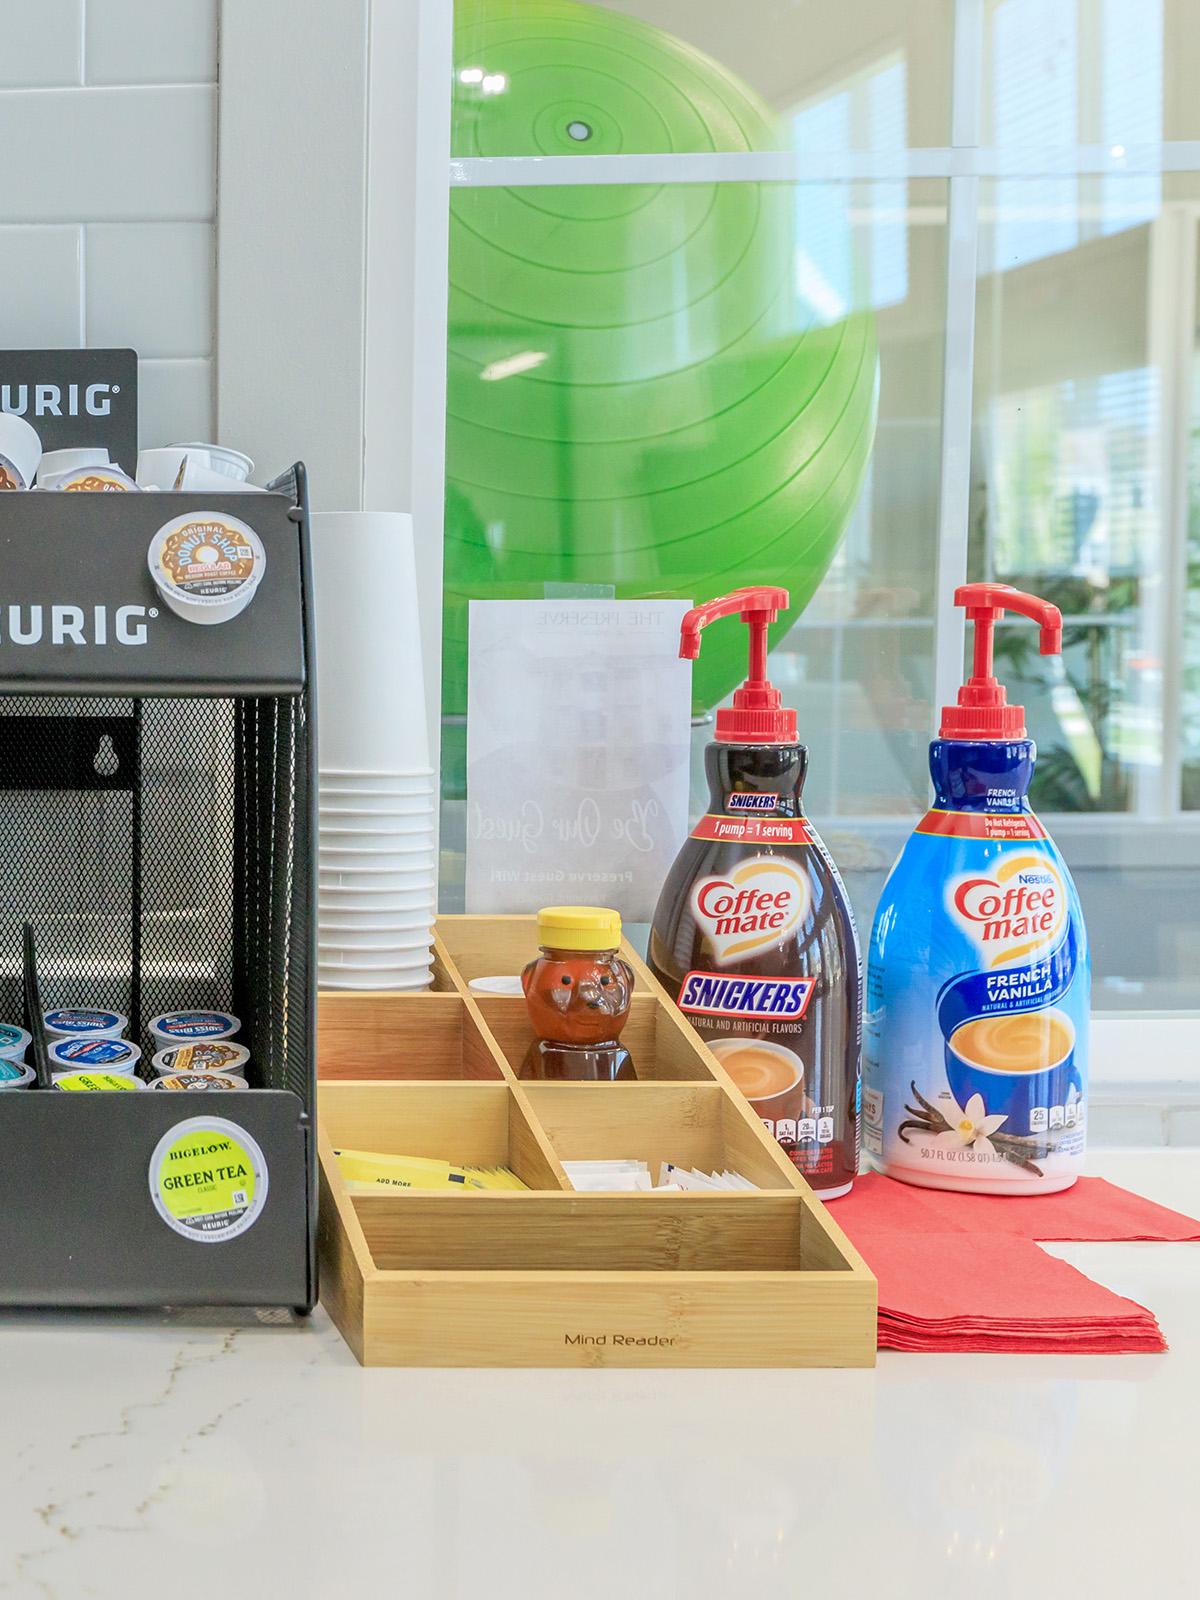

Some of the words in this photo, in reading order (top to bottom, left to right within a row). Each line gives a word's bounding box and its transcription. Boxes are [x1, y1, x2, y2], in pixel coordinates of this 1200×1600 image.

[182, 525, 224, 537] ORIGINAL
[177, 532, 206, 567] DONUT
[211, 533, 238, 562] SHOP
[730, 795, 776, 808] SNICKERS
[987, 788, 1017, 797] FRENCH
[714, 821, 720, 832] 1
[719, 824, 745, 838] pump
[755, 824, 760, 836] 1
[762, 824, 793, 840] serving
[697, 880, 791, 919] Coffee
[954, 879, 1055, 922] Coffee
[714, 911, 785, 936] mate
[981, 911, 1054, 941] mate
[987, 965, 1052, 989] FRENCH
[682, 977, 808, 1013] SNICKERS
[987, 979, 1053, 1002] VANILLA
[716, 1020, 731, 1031] AND
[732, 1021, 770, 1034] ARTIFICIAL
[772, 1022, 803, 1034] FLAVORS
[1033, 1110, 1045, 1121] 25
[169, 1142, 231, 1161] BIGELOW
[921, 1148, 936, 1160] 50.7
[937, 1150, 945, 1161] FL
[946, 1150, 957, 1161] OZ
[958, 1150, 976, 1163] (1.58
[977, 1152, 991, 1164] QT)
[163, 1170, 214, 1191] GREEN
[216, 1163, 248, 1181] TEA
[376, 1177, 390, 1185] ADD
[391, 1180, 413, 1188] MORE
[564, 1333, 607, 1346] Mind
[612, 1333, 677, 1347] Reader
